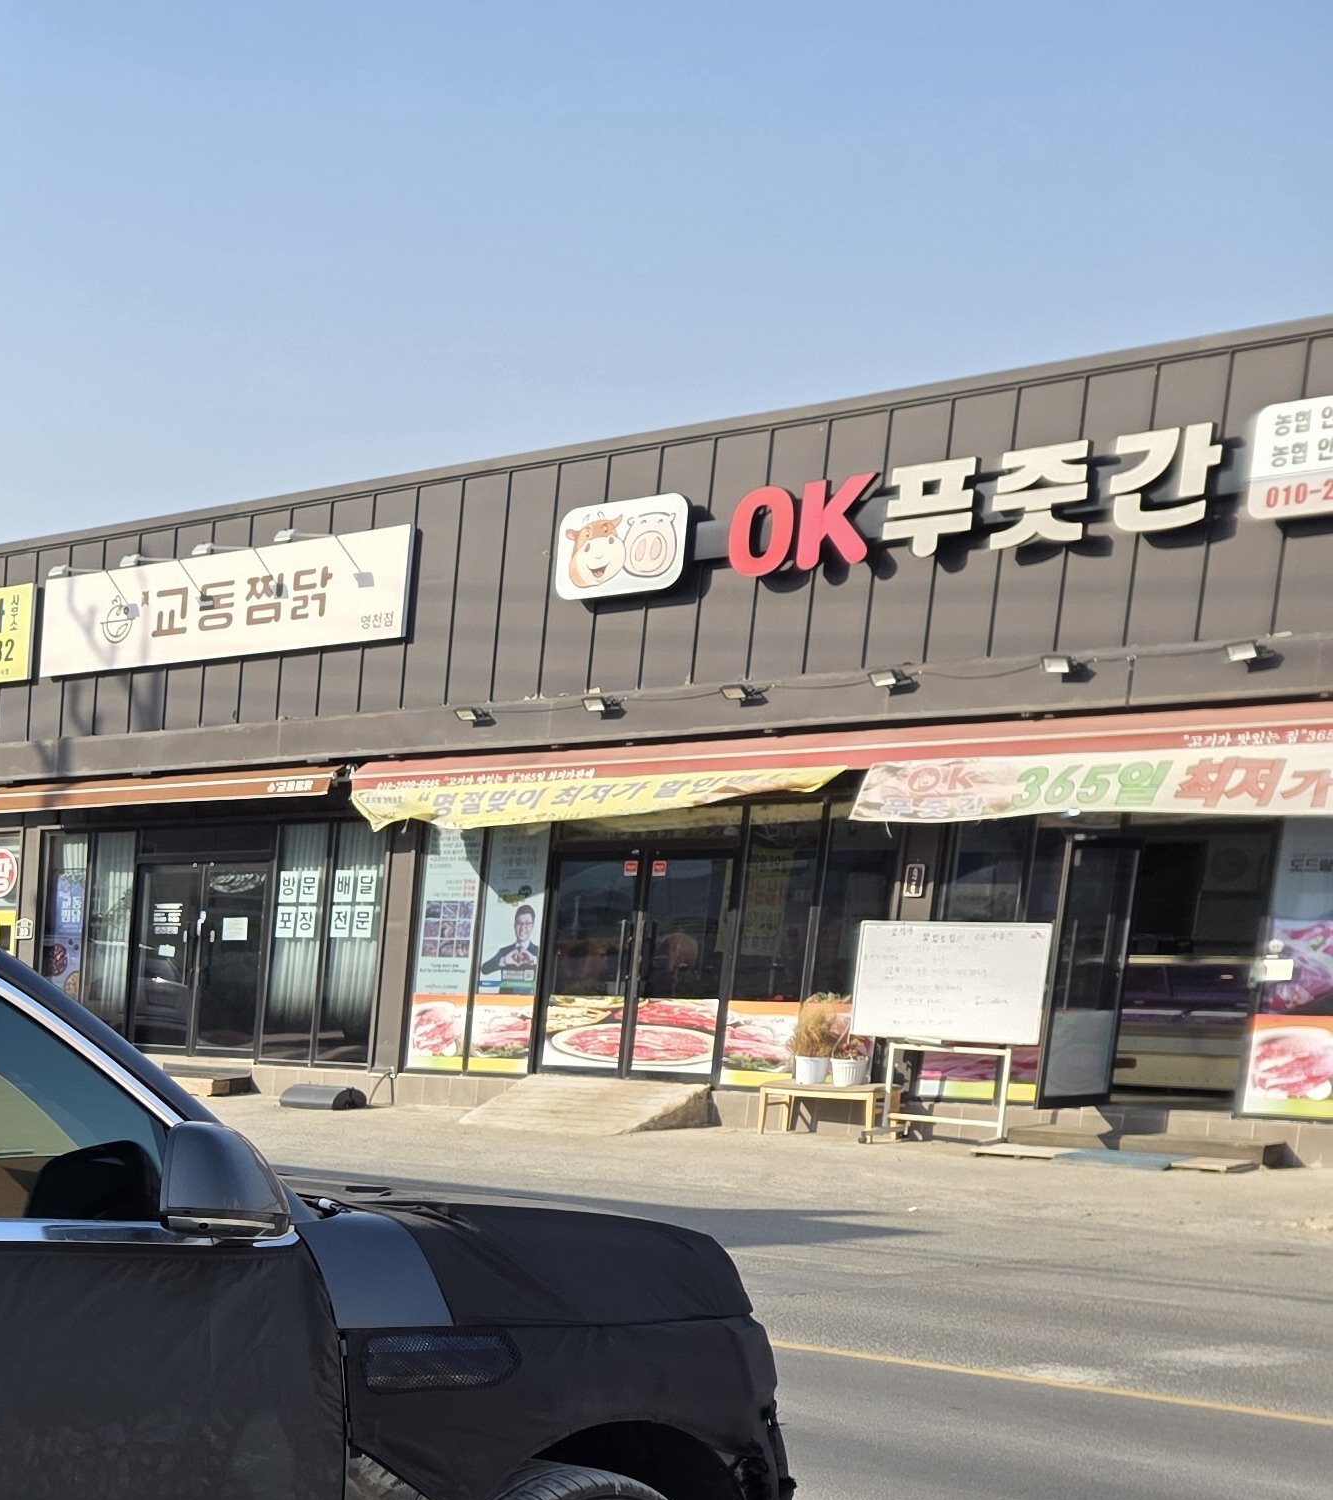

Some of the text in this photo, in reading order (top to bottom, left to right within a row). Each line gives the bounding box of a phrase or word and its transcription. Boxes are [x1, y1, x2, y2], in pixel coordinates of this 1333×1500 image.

[1274, 408, 1313, 436] 농협
[1271, 440, 1309, 468] 농협
[727, 422, 1223, 578] OK 푸줏간
[10, 594, 20, 632] 사무소
[151, 566, 333, 638] 교동찜닭
[360, 611, 395, 629] 영천점
[551, 780, 650, 806] 최저가
[908, 766, 974, 793] OK
[1010, 760, 1172, 809] 365일
[282, 876, 316, 896] 방문
[337, 875, 375, 895] 배달
[278, 911, 313, 931] 포장
[334, 910, 370, 930] 전문
